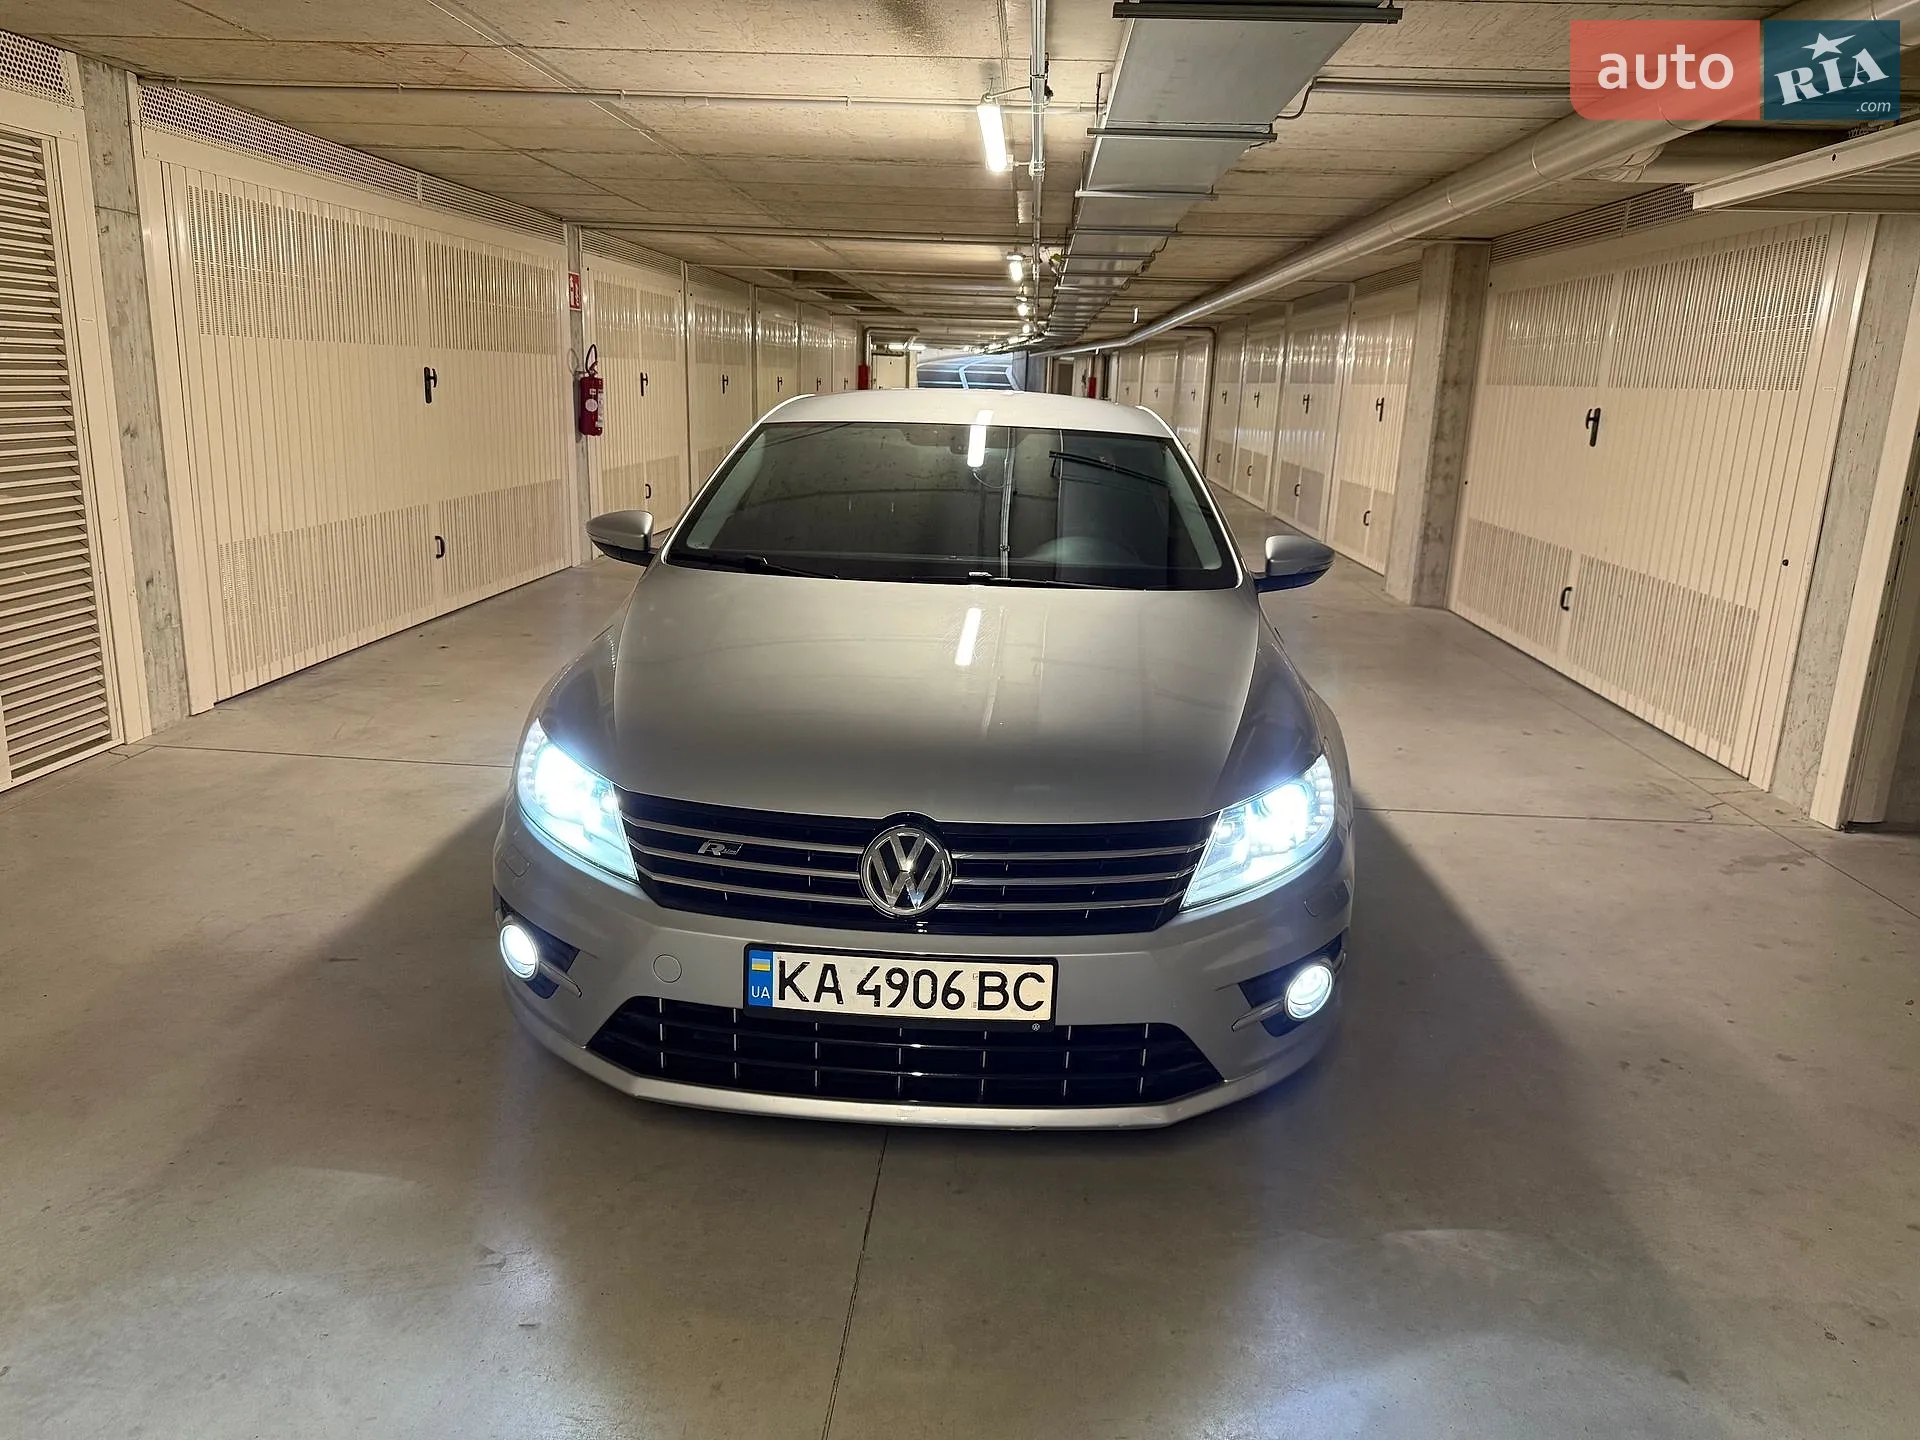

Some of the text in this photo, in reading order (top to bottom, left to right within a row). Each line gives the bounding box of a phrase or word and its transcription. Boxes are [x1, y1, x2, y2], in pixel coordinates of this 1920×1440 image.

[751, 959, 1046, 1012] UA KA 4906 BC
